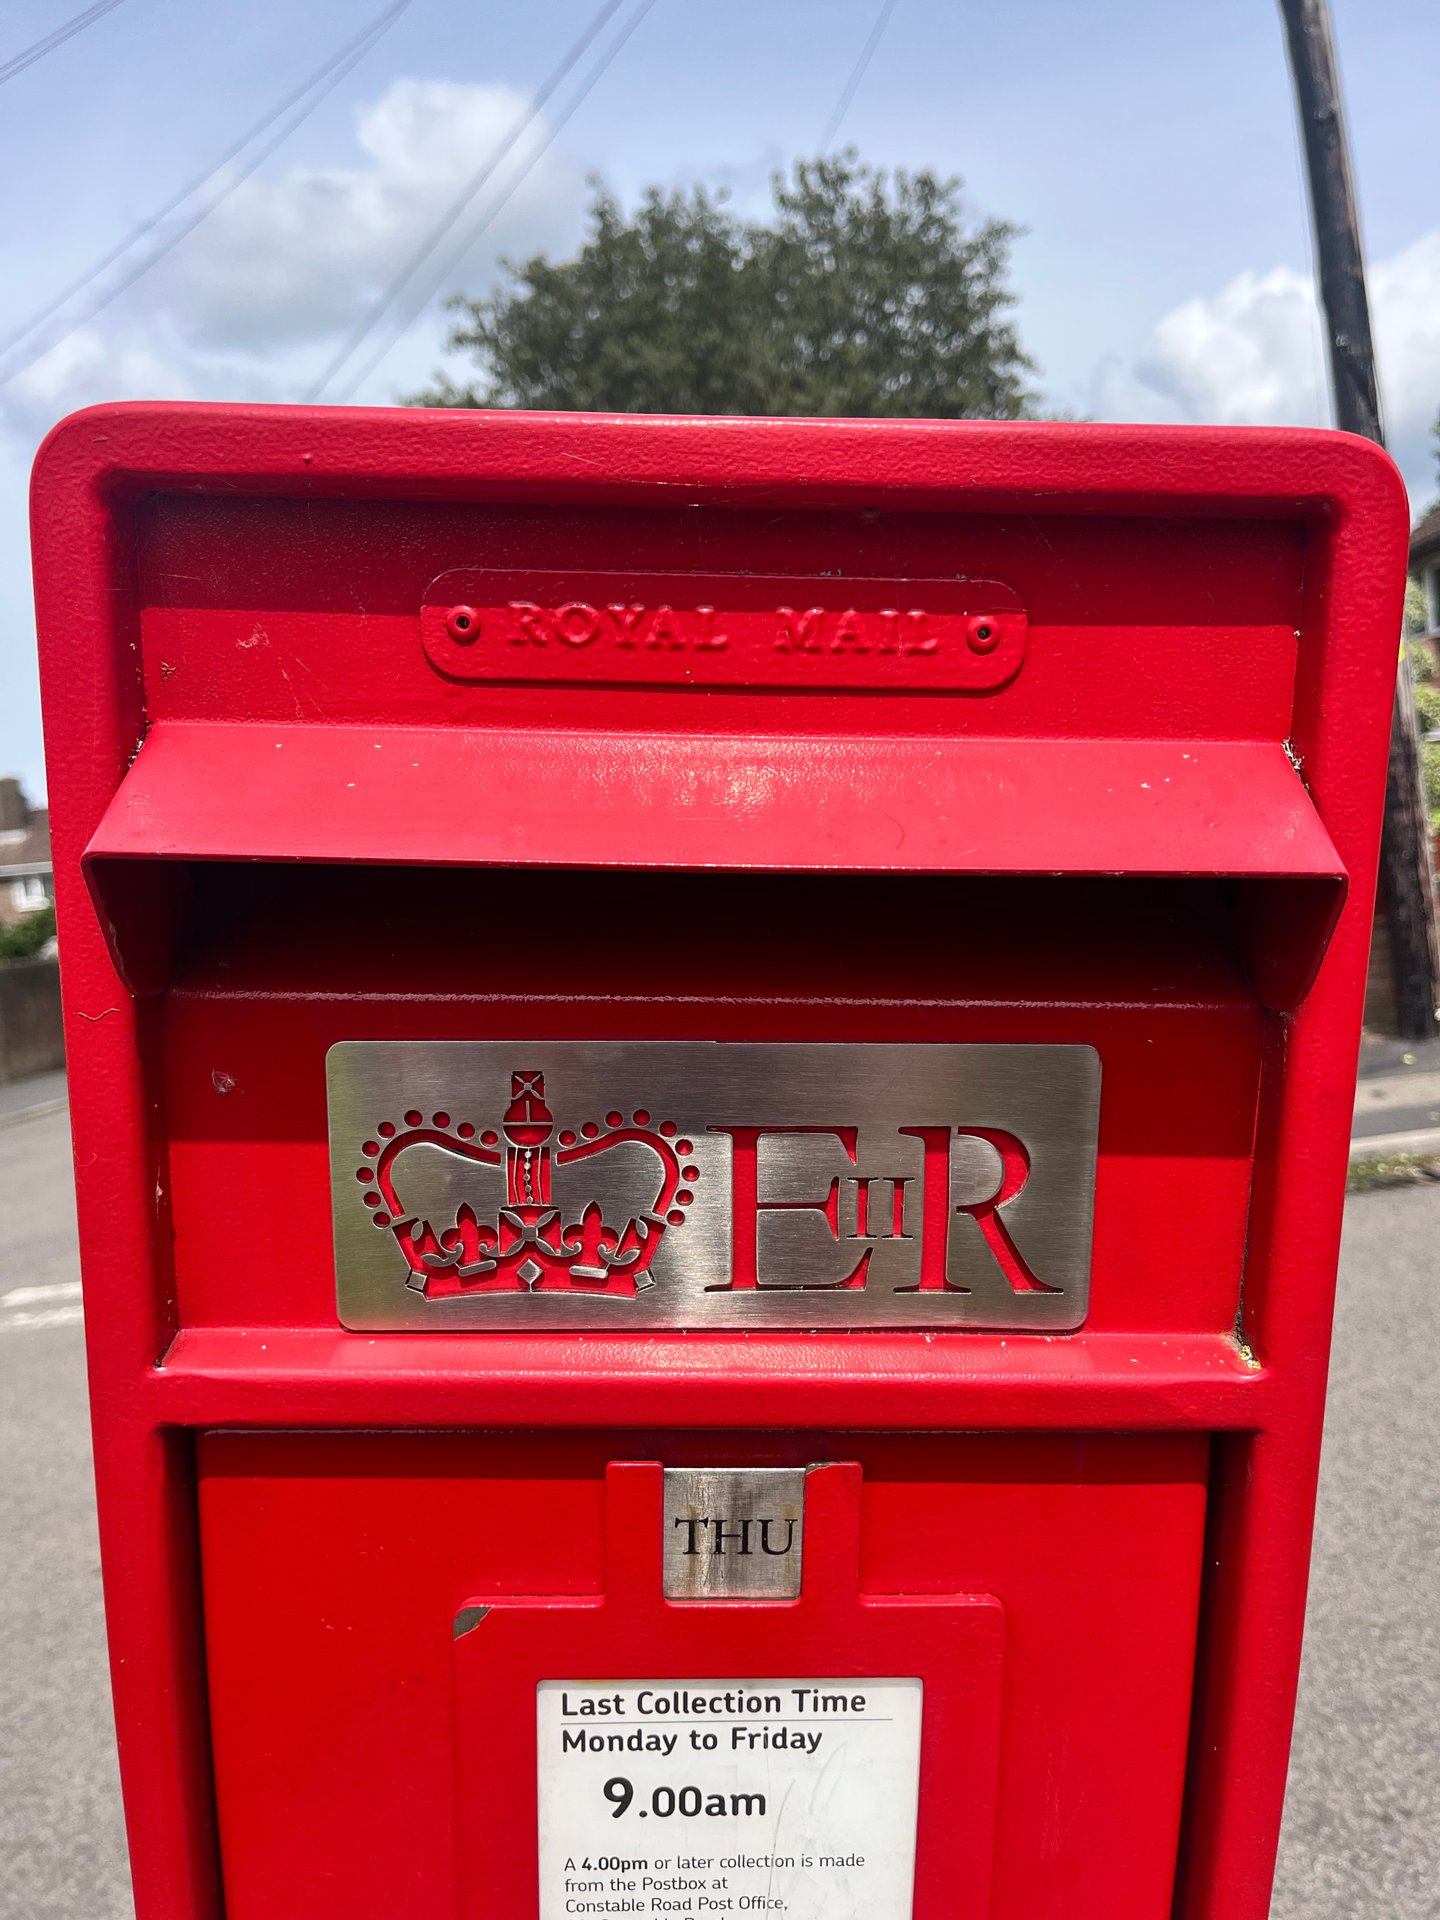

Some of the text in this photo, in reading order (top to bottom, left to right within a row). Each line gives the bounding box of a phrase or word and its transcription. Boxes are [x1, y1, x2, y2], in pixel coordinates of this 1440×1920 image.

[508, 600, 939, 656] ROYAL MAIL
[674, 1517, 798, 1555] THU
[562, 1689, 866, 1716] Last Collection Time
[562, 1727, 823, 1756] Monday to Friday
[603, 1776, 766, 1819] 9.00am
[564, 1853, 865, 1873] A 4.00pm or later collection is made
[564, 1876, 728, 1892] from the Postbox at
[566, 1895, 788, 1913] Constable Road Post Office,
